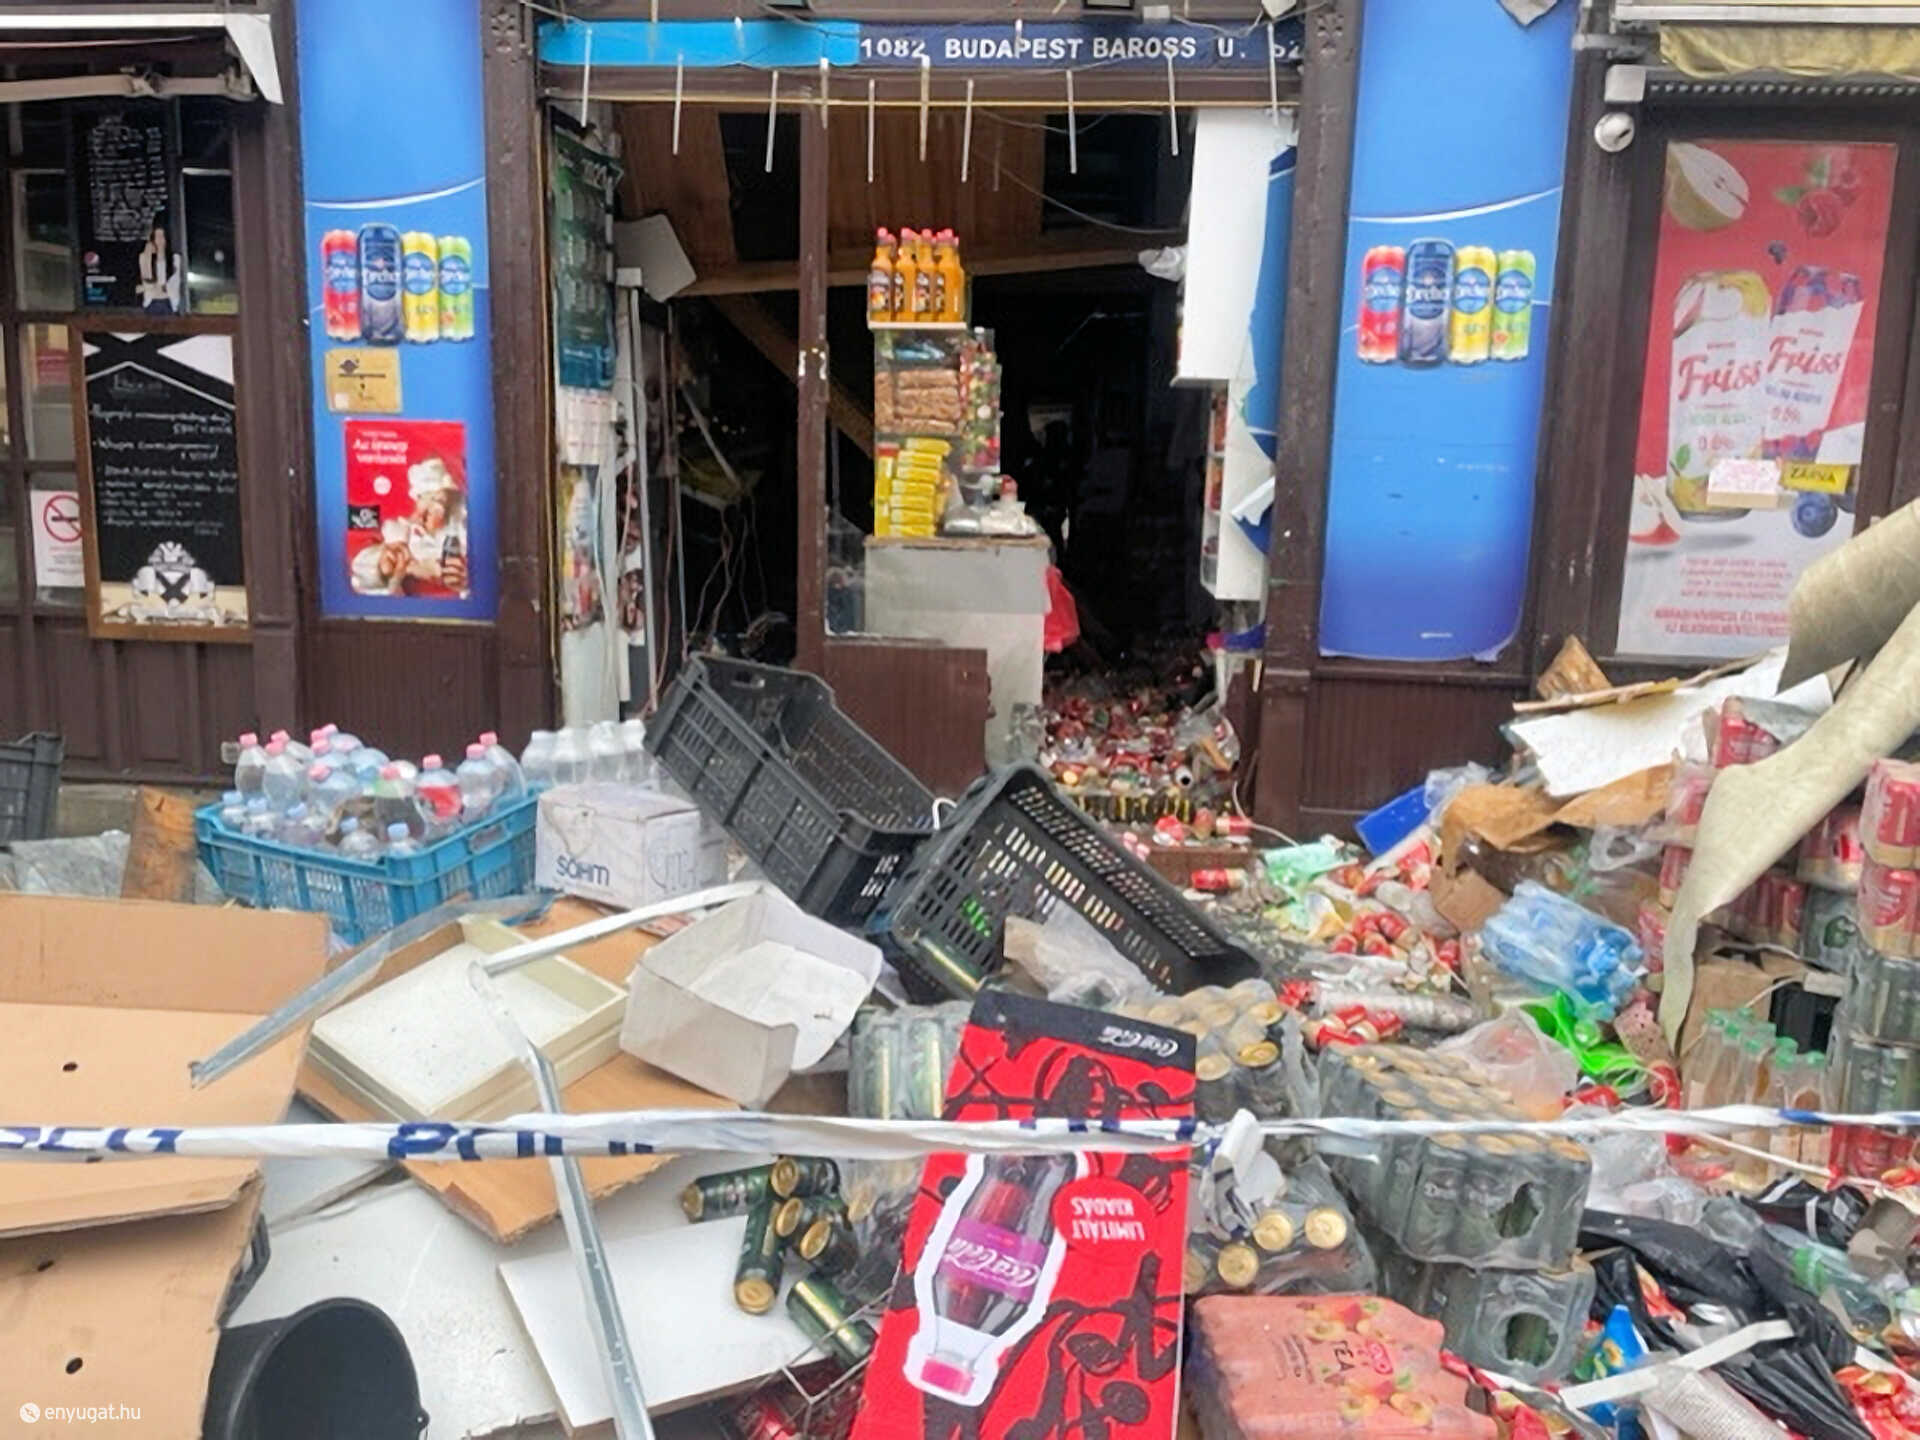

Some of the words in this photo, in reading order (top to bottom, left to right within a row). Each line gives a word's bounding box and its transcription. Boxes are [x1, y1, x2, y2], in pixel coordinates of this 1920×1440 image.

[860, 38, 927, 59] 1082
[945, 38, 1084, 59] BUDAPEST
[1093, 37, 1197, 59] BAROSS
[1218, 37, 1246, 58] U.
[1767, 336, 1843, 375] Friss
[1678, 352, 1763, 402] Friss
[1069, 1197, 1135, 1219] KIADÁS
[1070, 1220, 1146, 1245] LIMITÁLT
